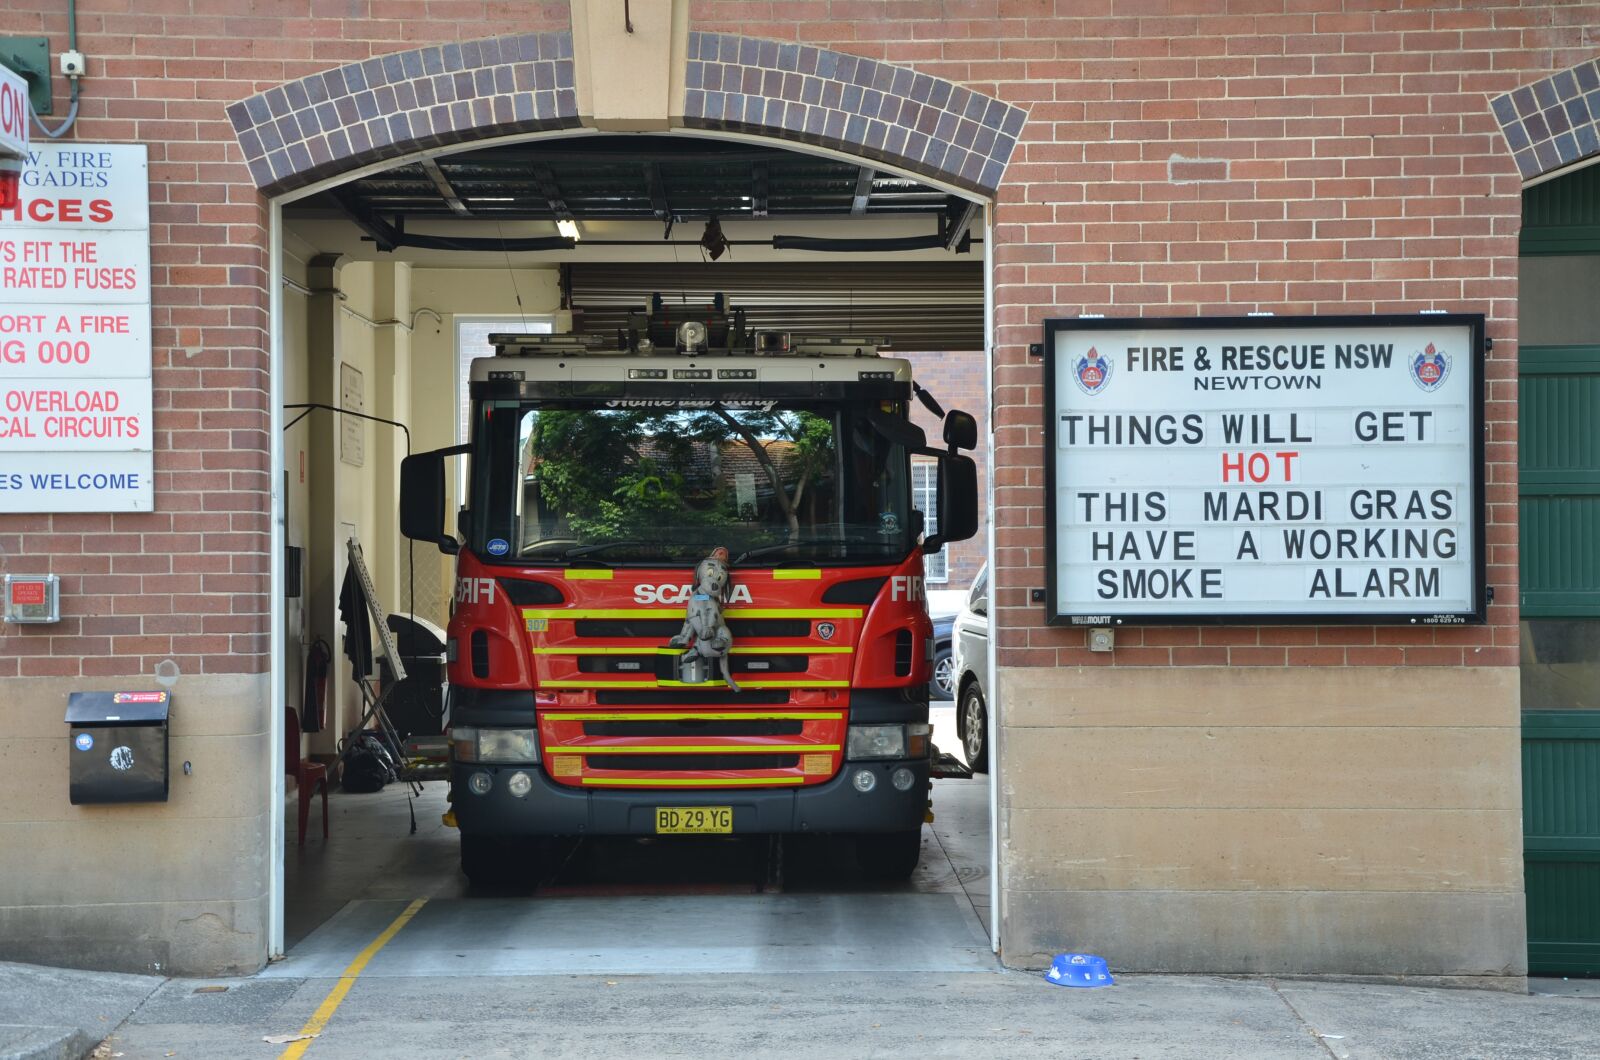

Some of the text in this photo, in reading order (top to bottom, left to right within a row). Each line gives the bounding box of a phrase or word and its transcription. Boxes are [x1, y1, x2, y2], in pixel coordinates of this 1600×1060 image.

[58, 152, 112, 168] FIRE
[0, 199, 113, 222] ICES
[0, 241, 97, 263] S FIT THE
[4, 267, 136, 290] RATED FUSES
[56, 315, 72, 333] A
[80, 316, 130, 333] FIRE
[0, 340, 90, 364] G 000
[1127, 343, 1394, 372] FIRE & RESCUE NSW
[1194, 375, 1321, 391] NEWTOWN
[5, 390, 119, 412] OVERLOAD
[44, 416, 140, 438] CIRCUITS
[1061, 411, 1433, 445] THINGS WILL GET
[1223, 451, 1299, 483] HOT
[30, 473, 139, 489] WELCOME
[1077, 489, 1453, 522] THIS MARDI GRAS
[1092, 528, 1456, 561] HAVE A WORKING
[634, 584, 753, 604] SCAA
[1097, 567, 1440, 600] SMOKE ALARM
[527, 619, 546, 631] 307
